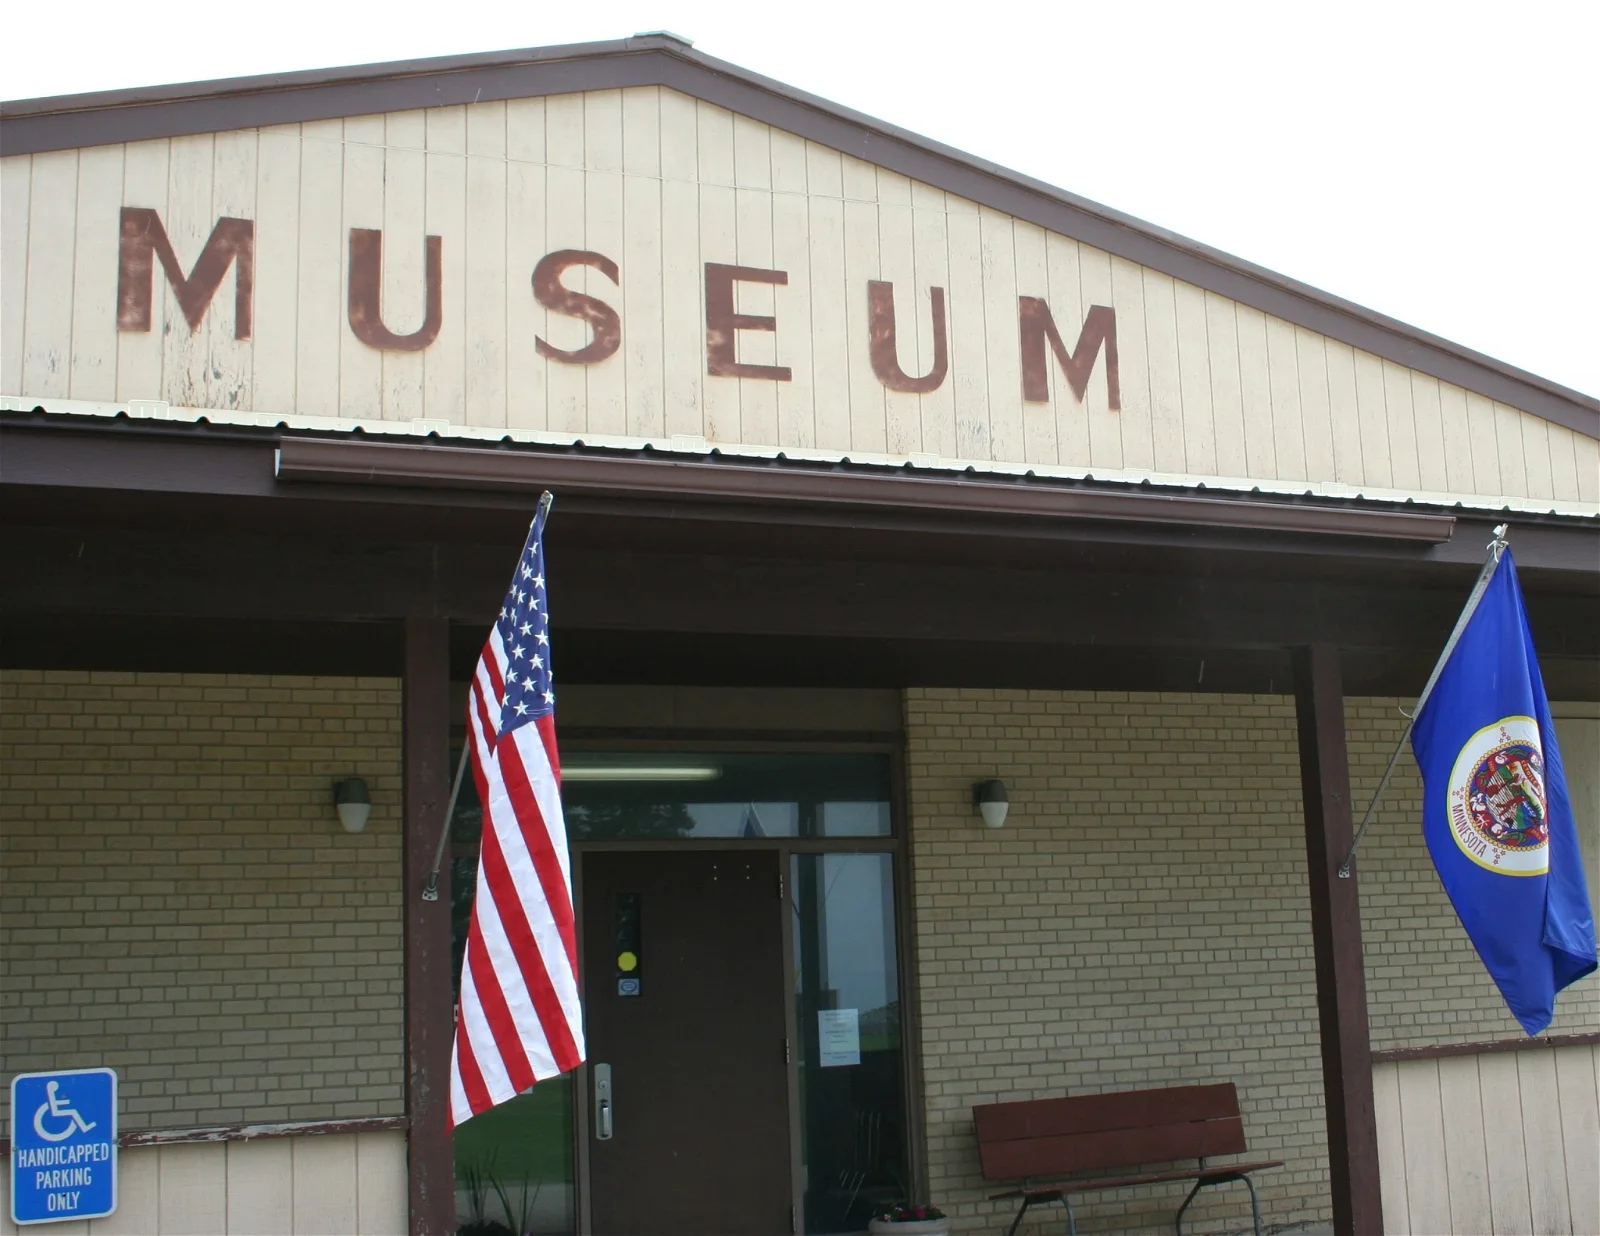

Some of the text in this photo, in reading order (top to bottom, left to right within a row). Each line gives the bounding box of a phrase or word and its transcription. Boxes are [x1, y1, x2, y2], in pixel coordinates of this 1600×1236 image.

[116, 206, 1122, 410] MUSEUM
[1451, 803, 1488, 858] MINNESOTA
[18, 1142, 110, 1168] HANDICAPPED
[36, 1167, 92, 1190] PARKING
[47, 1191, 81, 1212] ONLY
